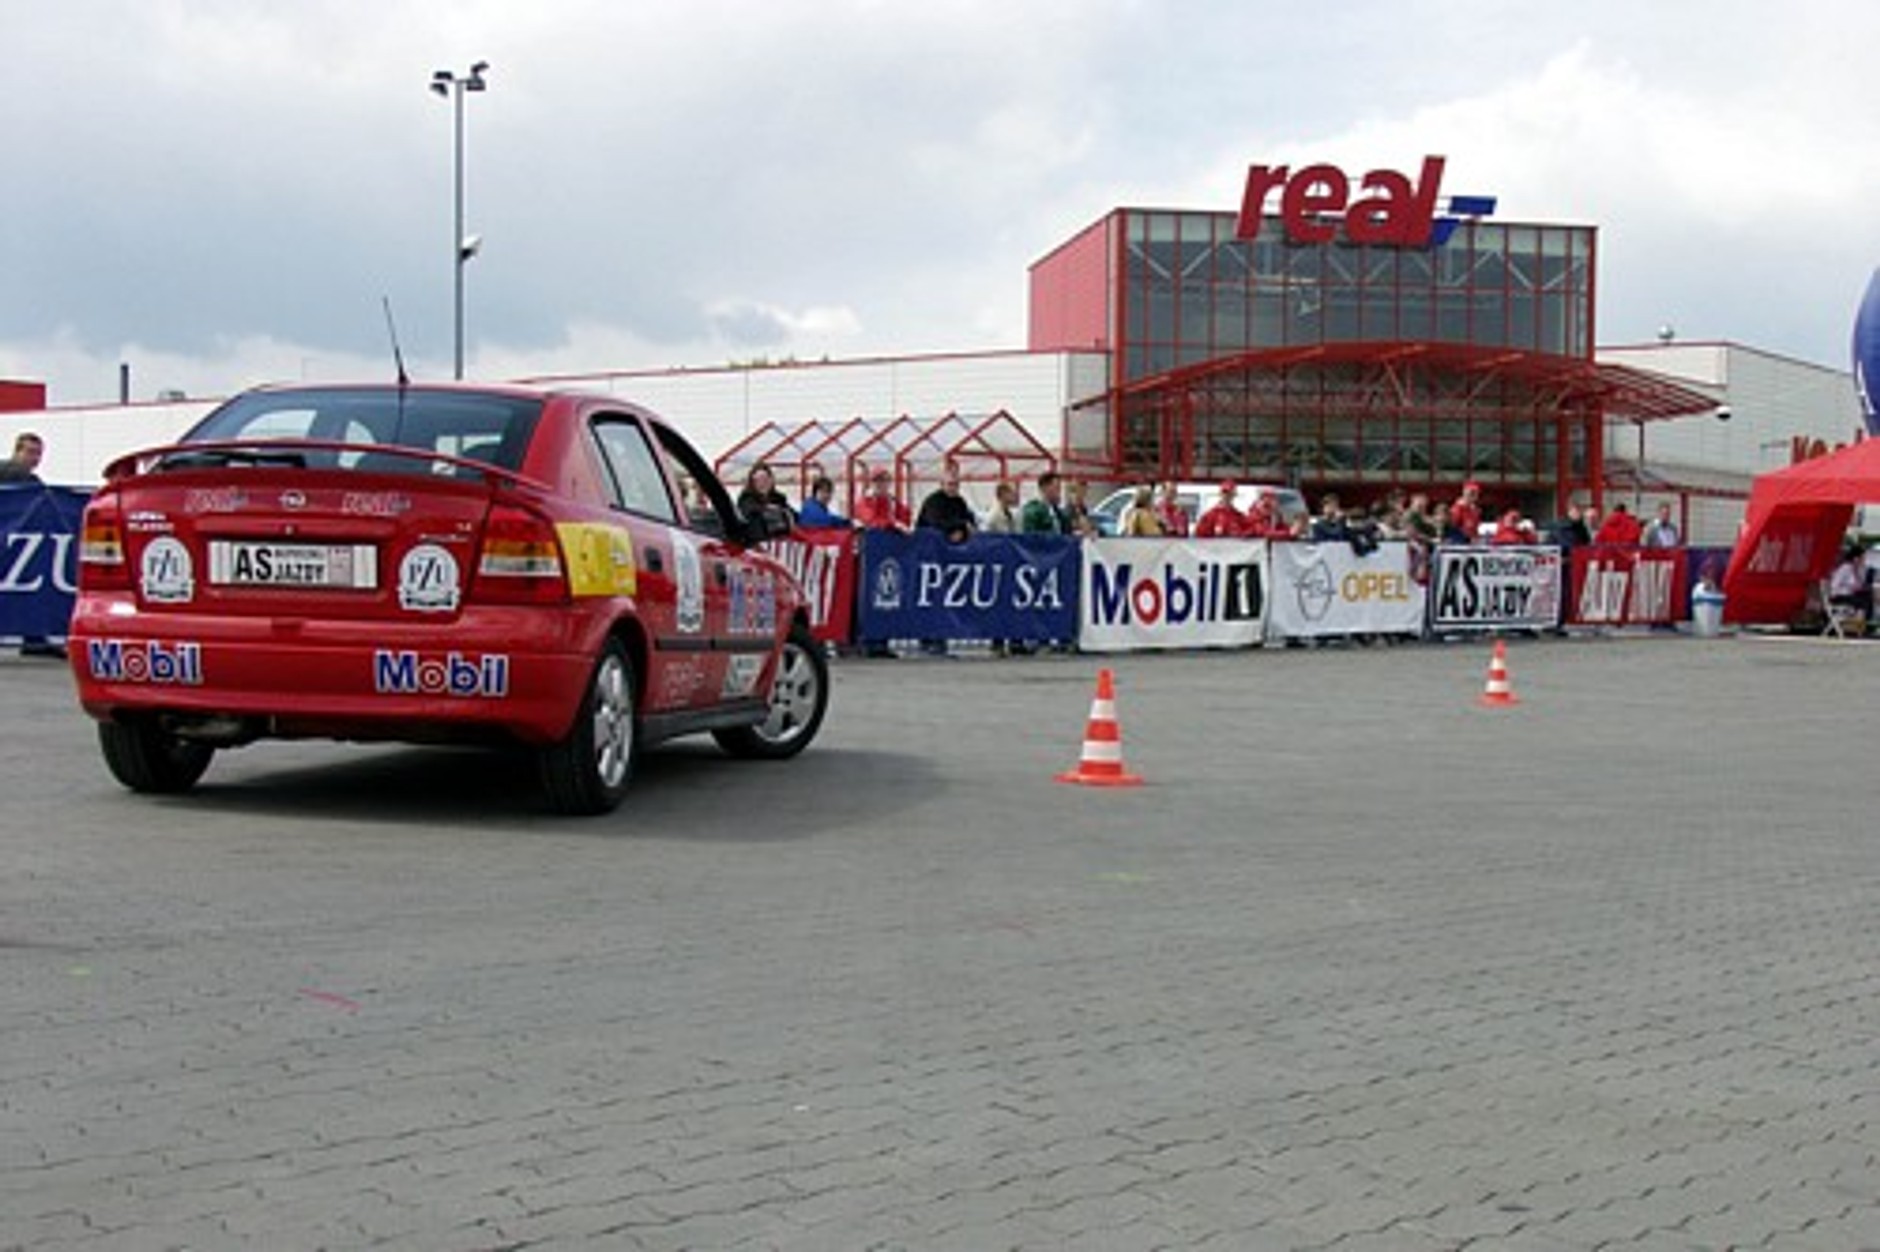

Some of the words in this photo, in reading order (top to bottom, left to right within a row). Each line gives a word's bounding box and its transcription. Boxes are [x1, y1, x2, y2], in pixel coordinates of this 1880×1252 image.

[1236, 154, 1447, 246] real
[234, 547, 273, 581] AS
[917, 562, 1000, 608] PZU
[1013, 563, 1062, 609] SA
[1341, 571, 1410, 603] OPEL
[1439, 556, 1480, 618] AS
[1091, 563, 1219, 626] Mobil
[88, 639, 203, 685] Mobil
[374, 650, 509, 697] Mobil
